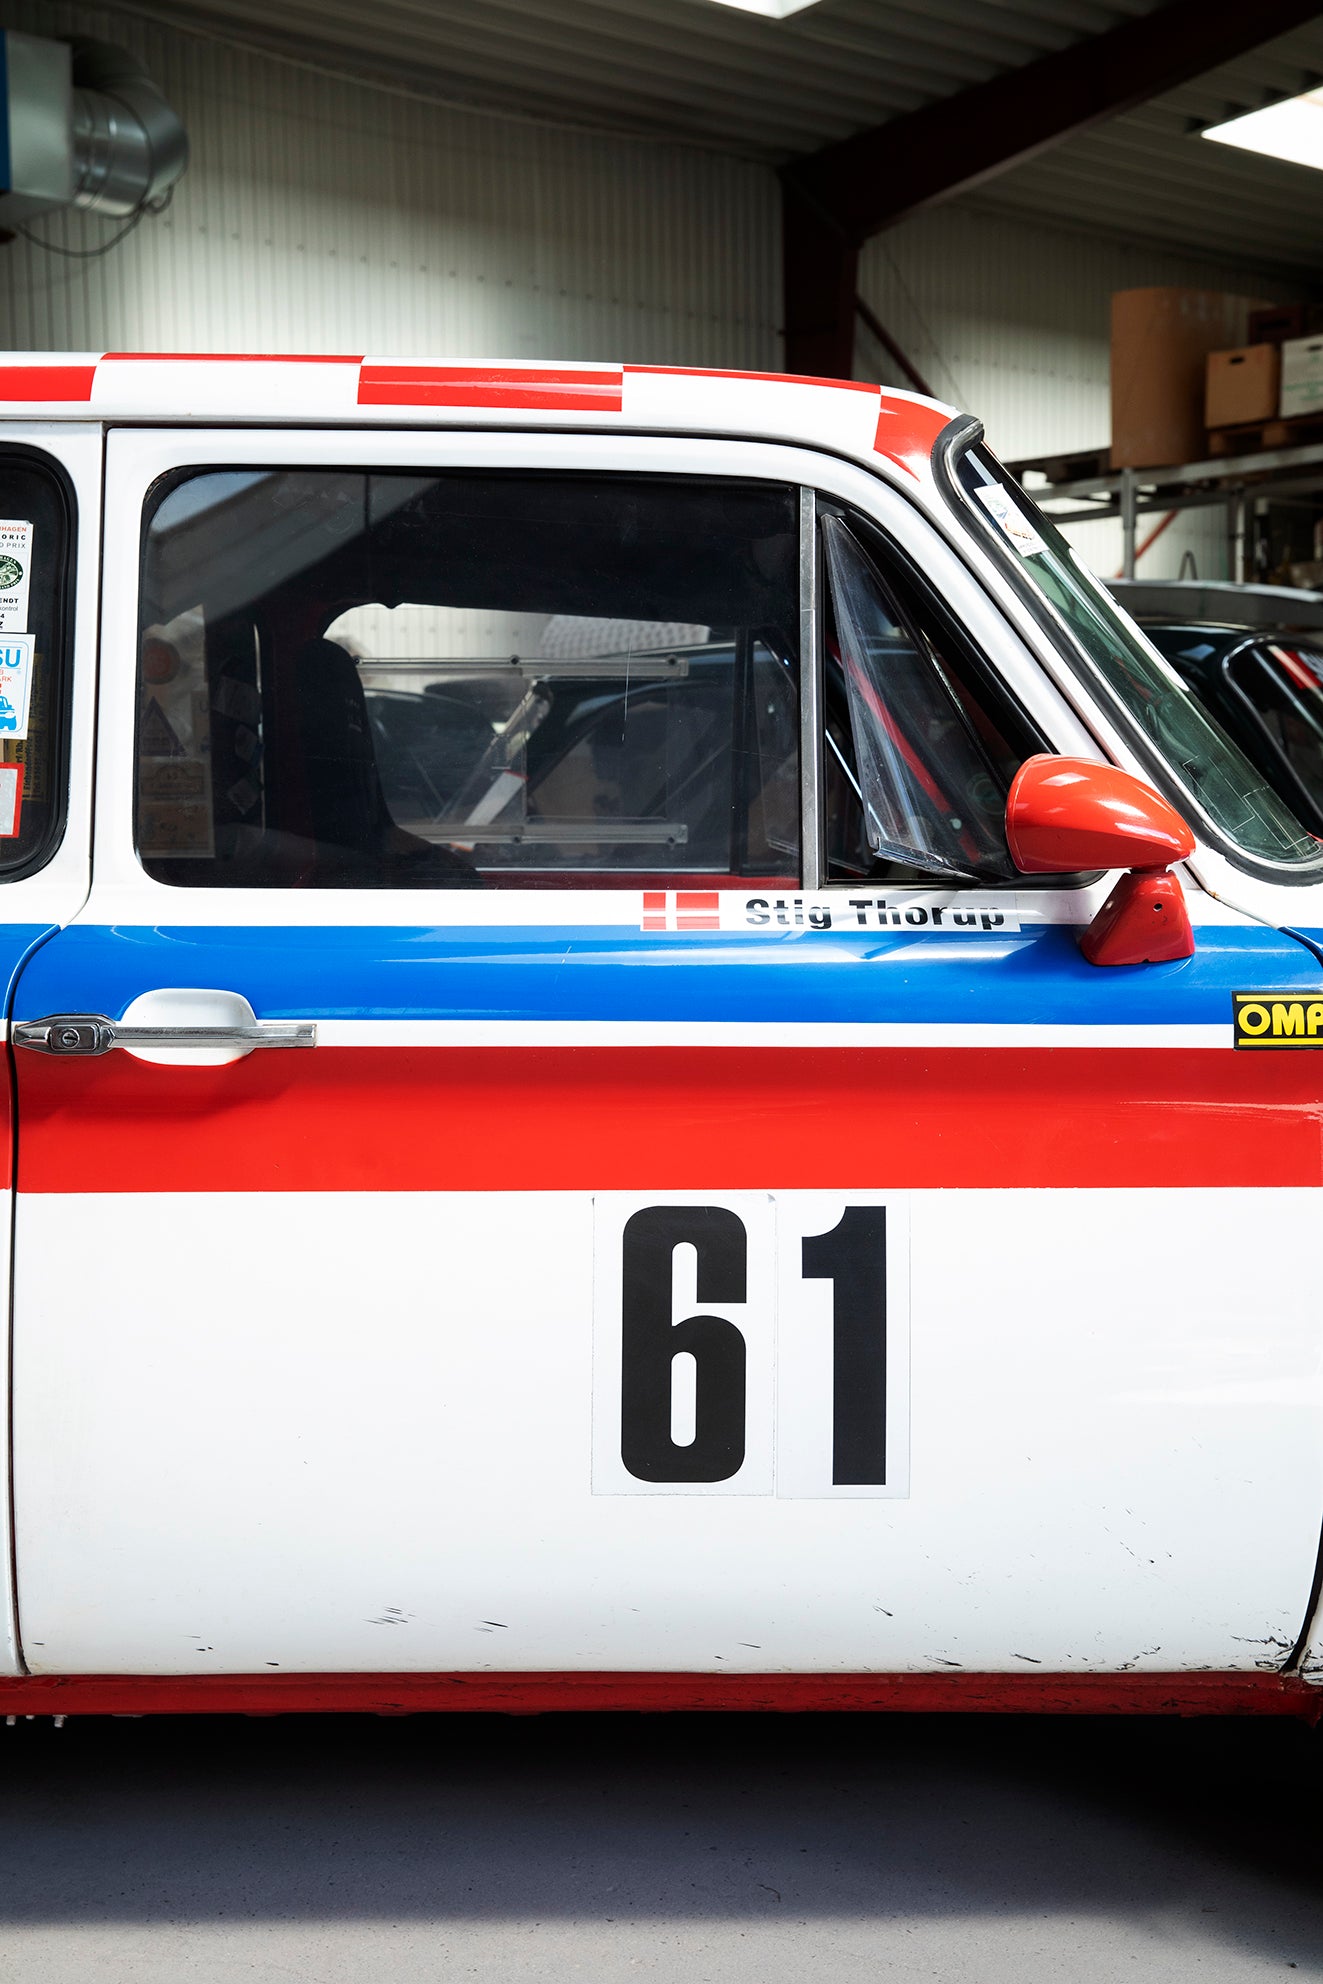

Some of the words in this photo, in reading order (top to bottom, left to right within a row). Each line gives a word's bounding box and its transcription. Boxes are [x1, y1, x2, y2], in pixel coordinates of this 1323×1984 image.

[745, 898, 832, 930] Stig
[849, 899, 1006, 931] Thorup
[1237, 1003, 1323, 1036] OMP
[621, 1205, 887, 1486] 61
